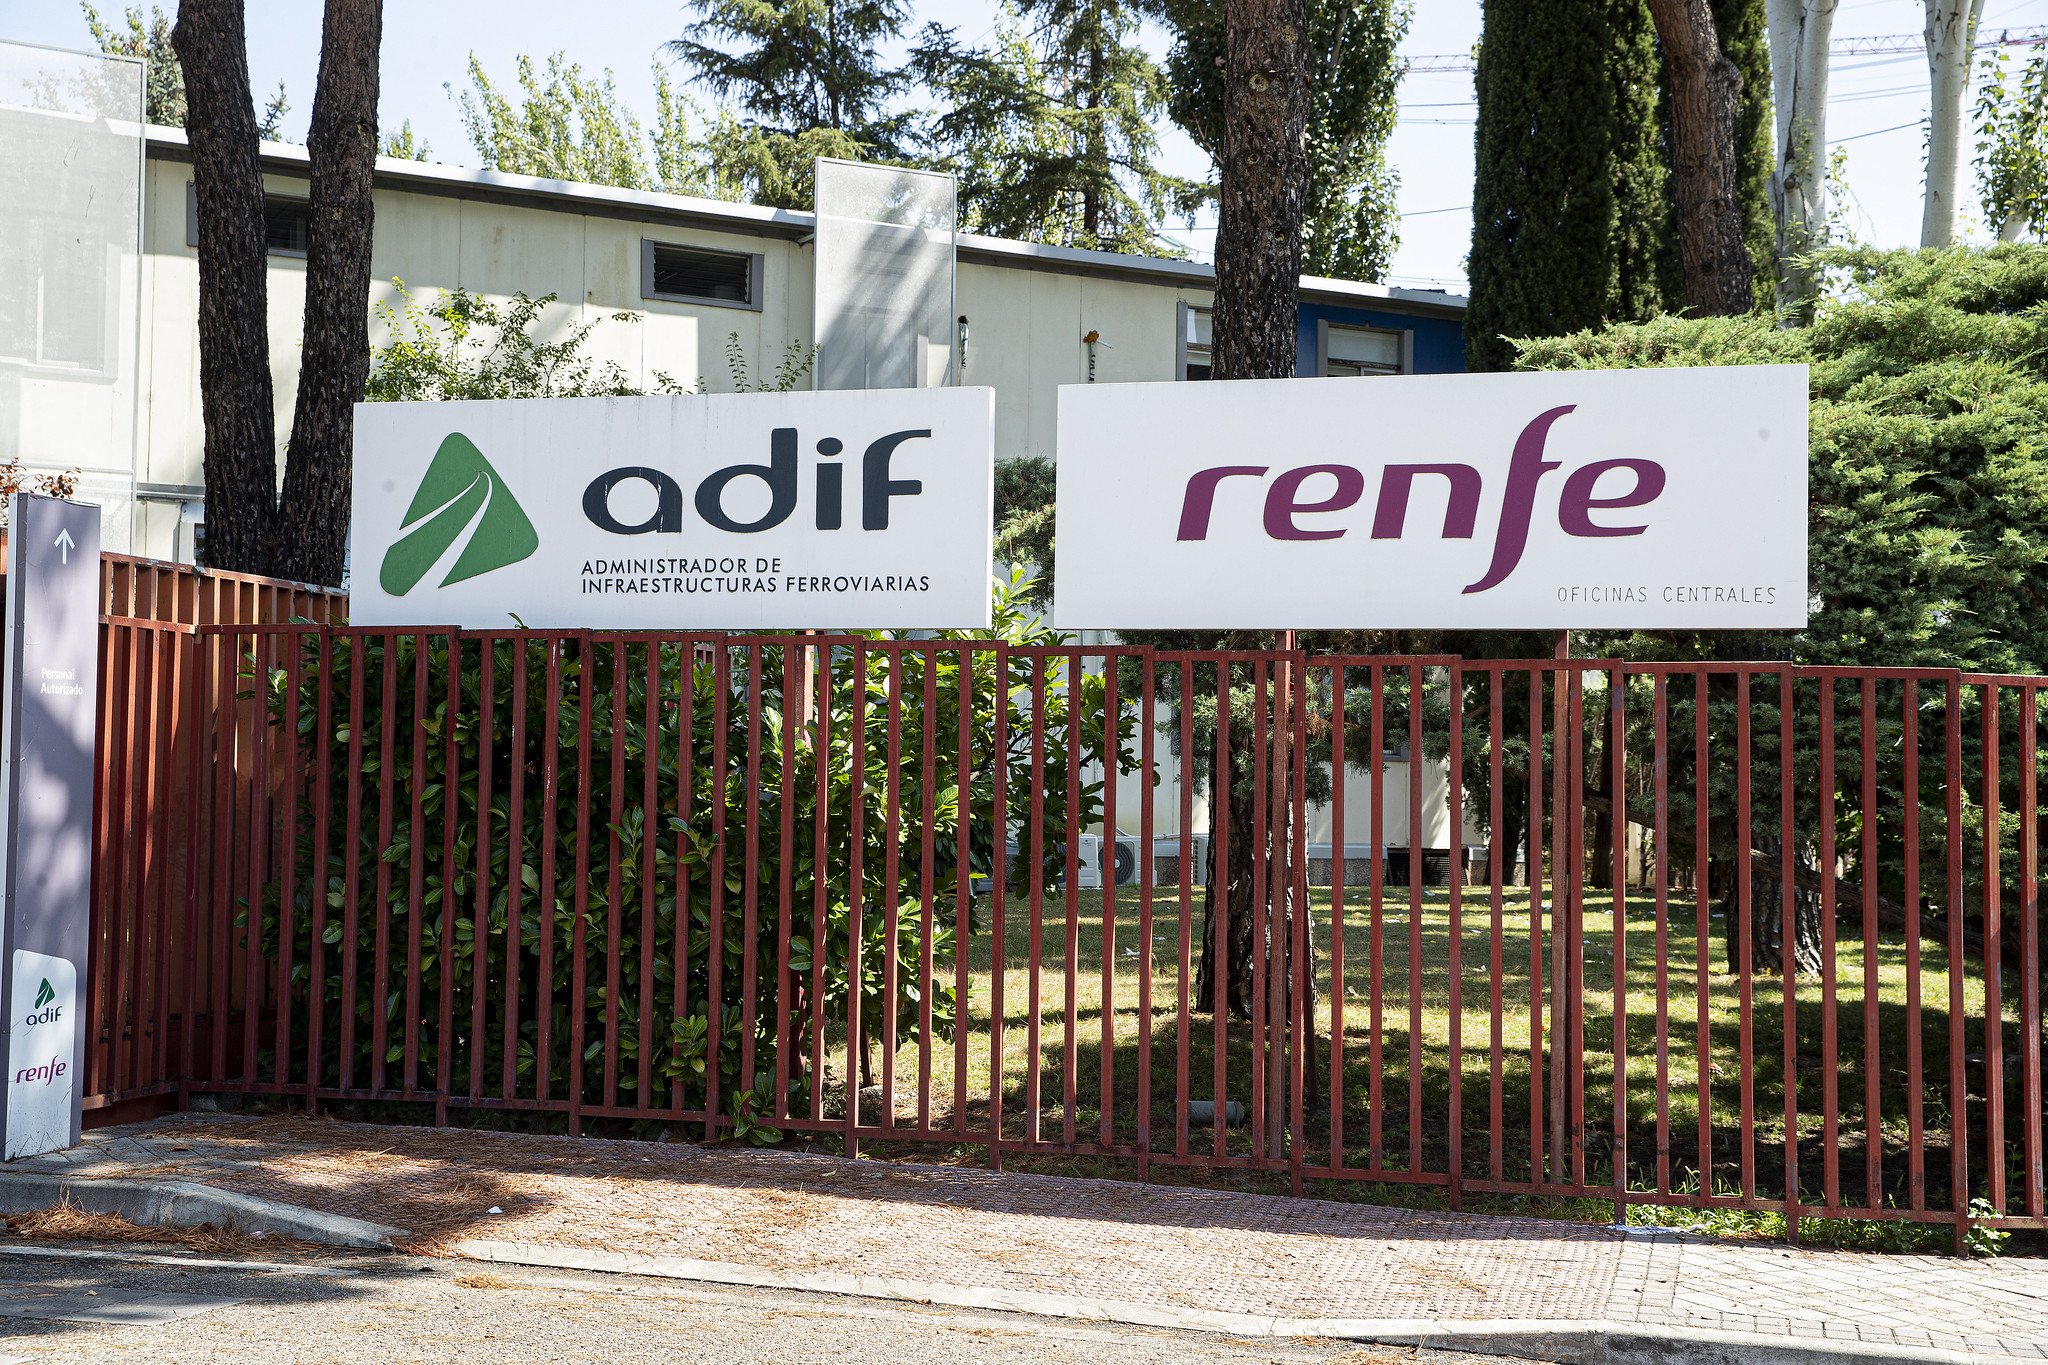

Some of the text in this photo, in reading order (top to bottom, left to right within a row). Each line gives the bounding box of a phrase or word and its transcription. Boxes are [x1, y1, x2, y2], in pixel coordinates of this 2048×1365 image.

[582, 427, 932, 535] adif
[1177, 404, 1666, 594] renfe
[581, 558, 781, 575] ADMINISTRADOR DE
[581, 576, 930, 594] INFRAESTRUCTURAS FERROVIARIAS
[1557, 587, 1776, 605] OFICINAS CENTRALES
[41, 667, 76, 681] Personal
[40, 682, 83, 696] Autorizado
[26, 1006, 62, 1026] adif
[16, 1055, 67, 1087] renfe
